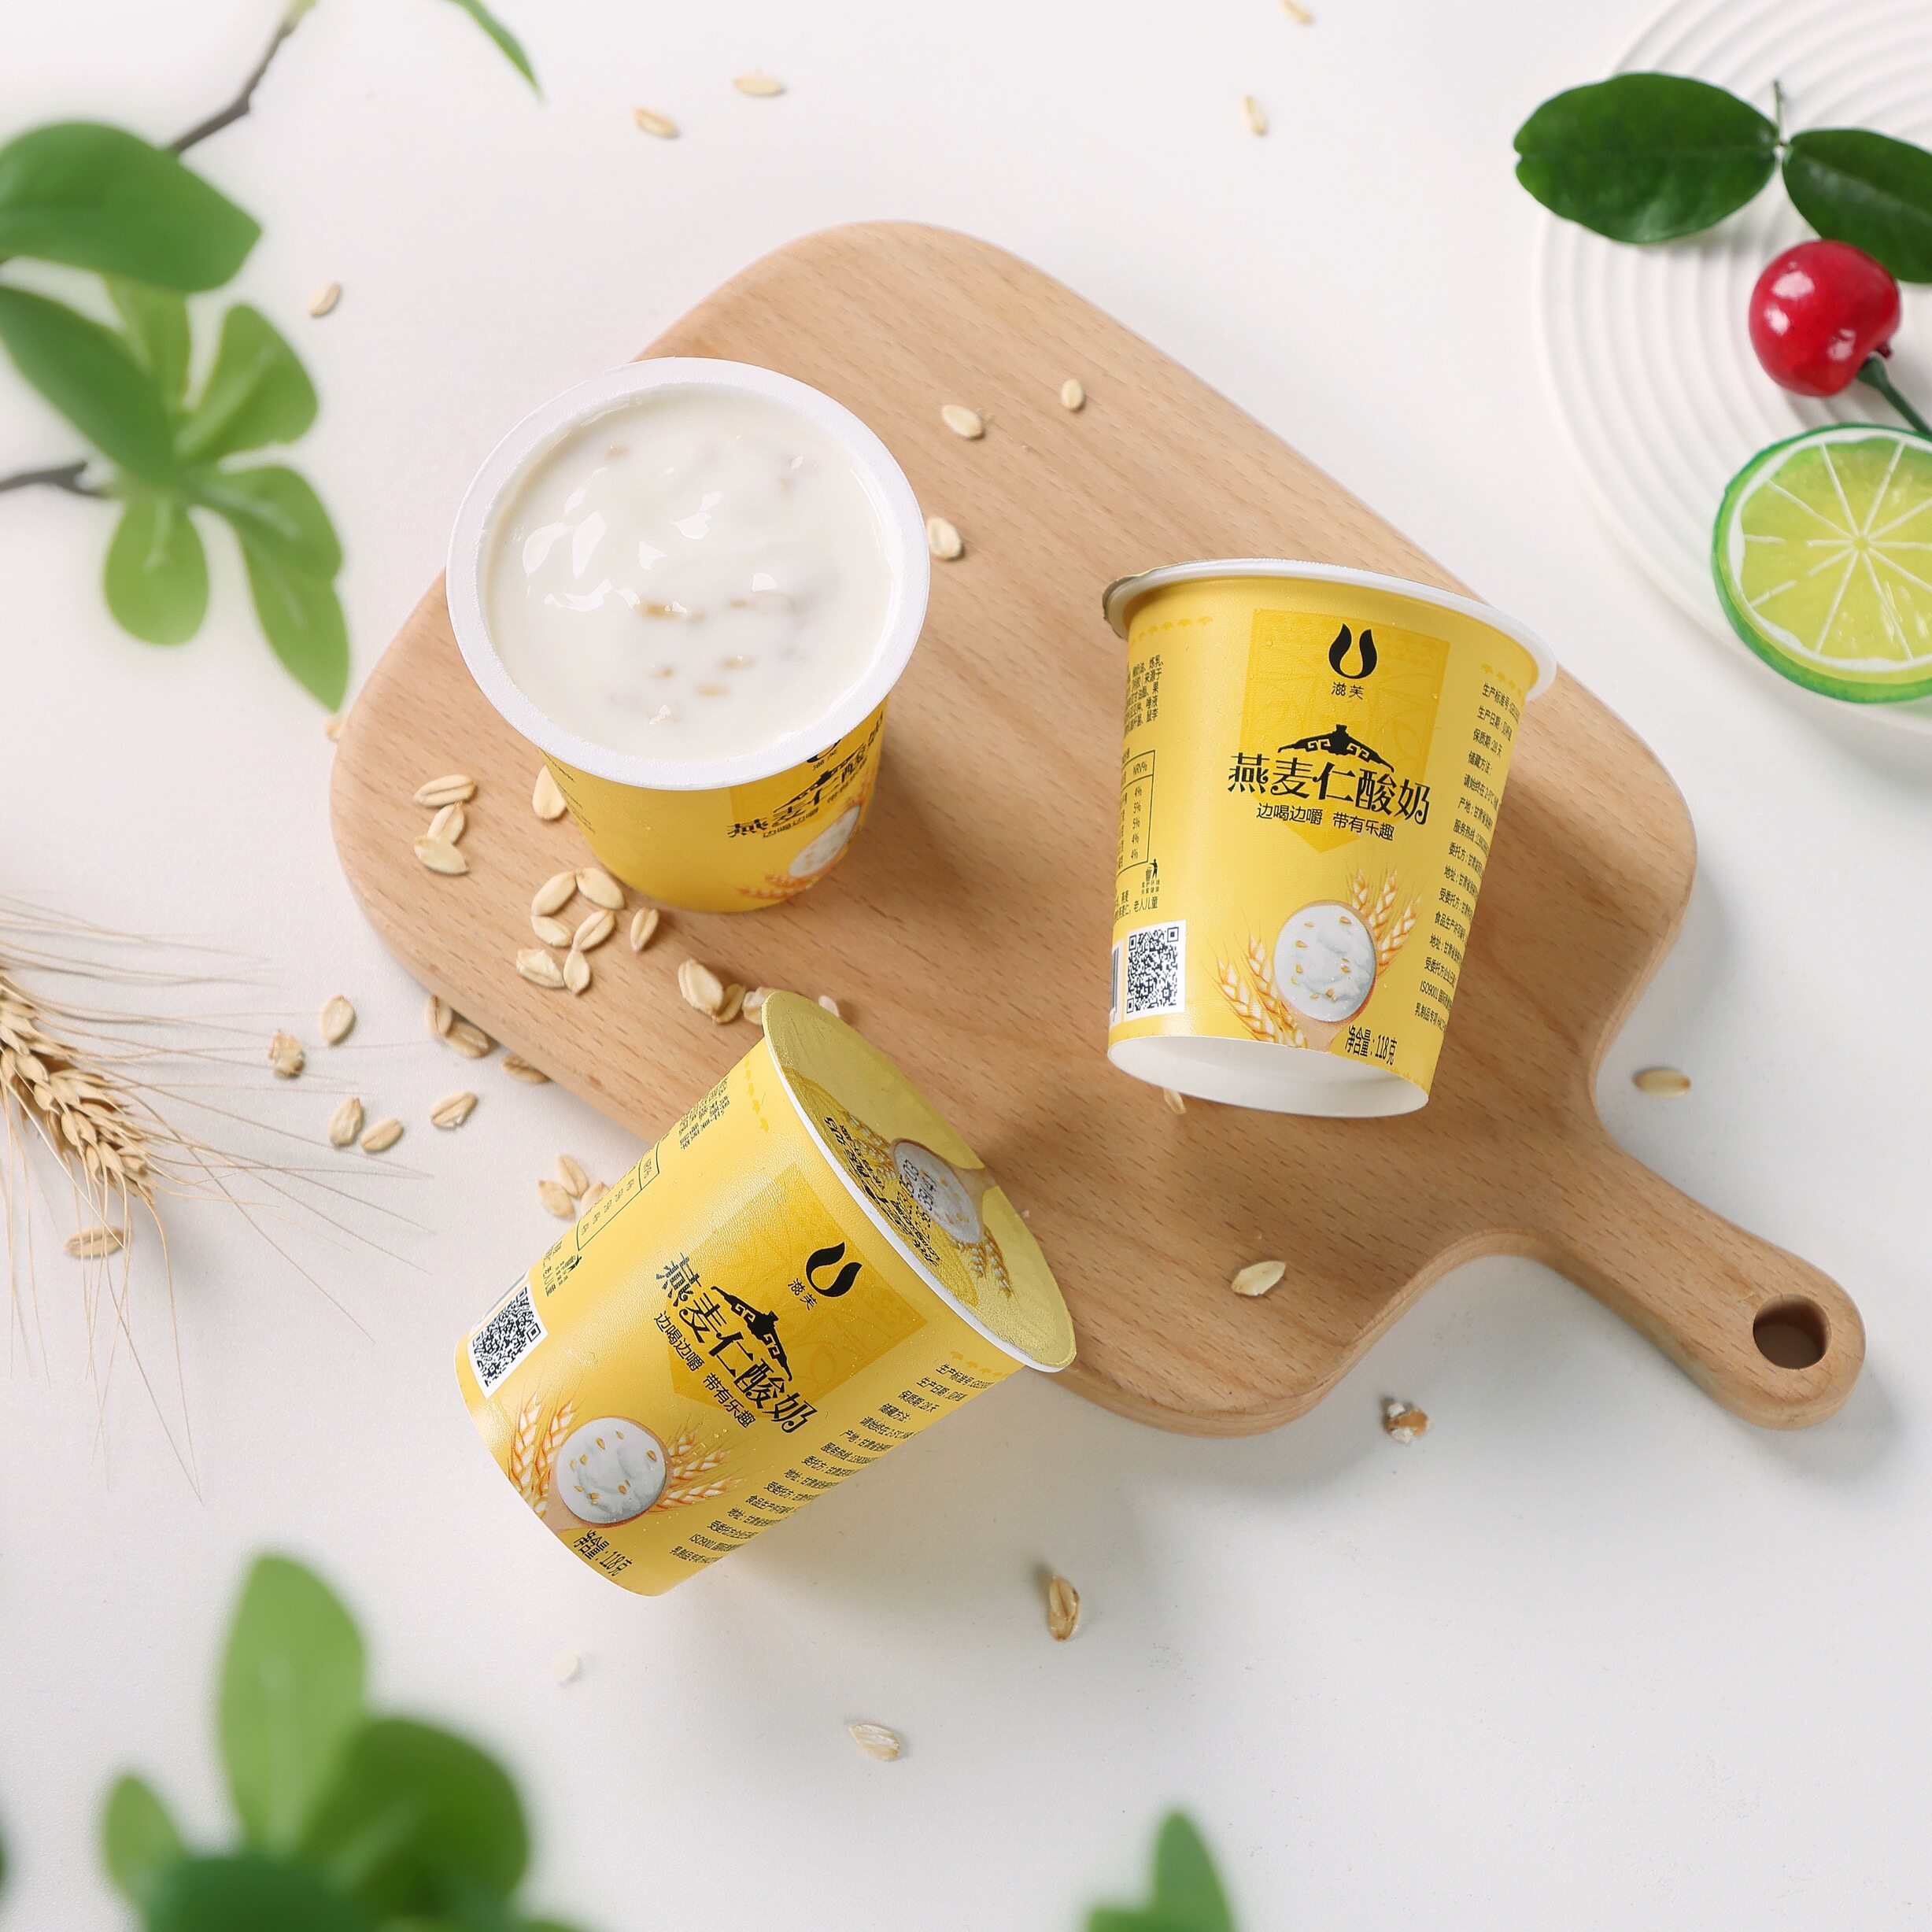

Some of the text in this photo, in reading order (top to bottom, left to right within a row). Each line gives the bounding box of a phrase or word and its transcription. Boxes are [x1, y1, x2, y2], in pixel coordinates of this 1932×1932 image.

[1332, 682, 1364, 700] 滋芙
[1228, 752, 1431, 825] 燕麦仁酸奶
[1256, 803, 1395, 841] 边喝边嚼 带有乐趣
[788, 1278, 818, 1310] 滋芙
[654, 1310, 756, 1428] 边喝边嚼 带有乐趣
[656, 1252, 818, 1433] 燕麦仁酸奶
